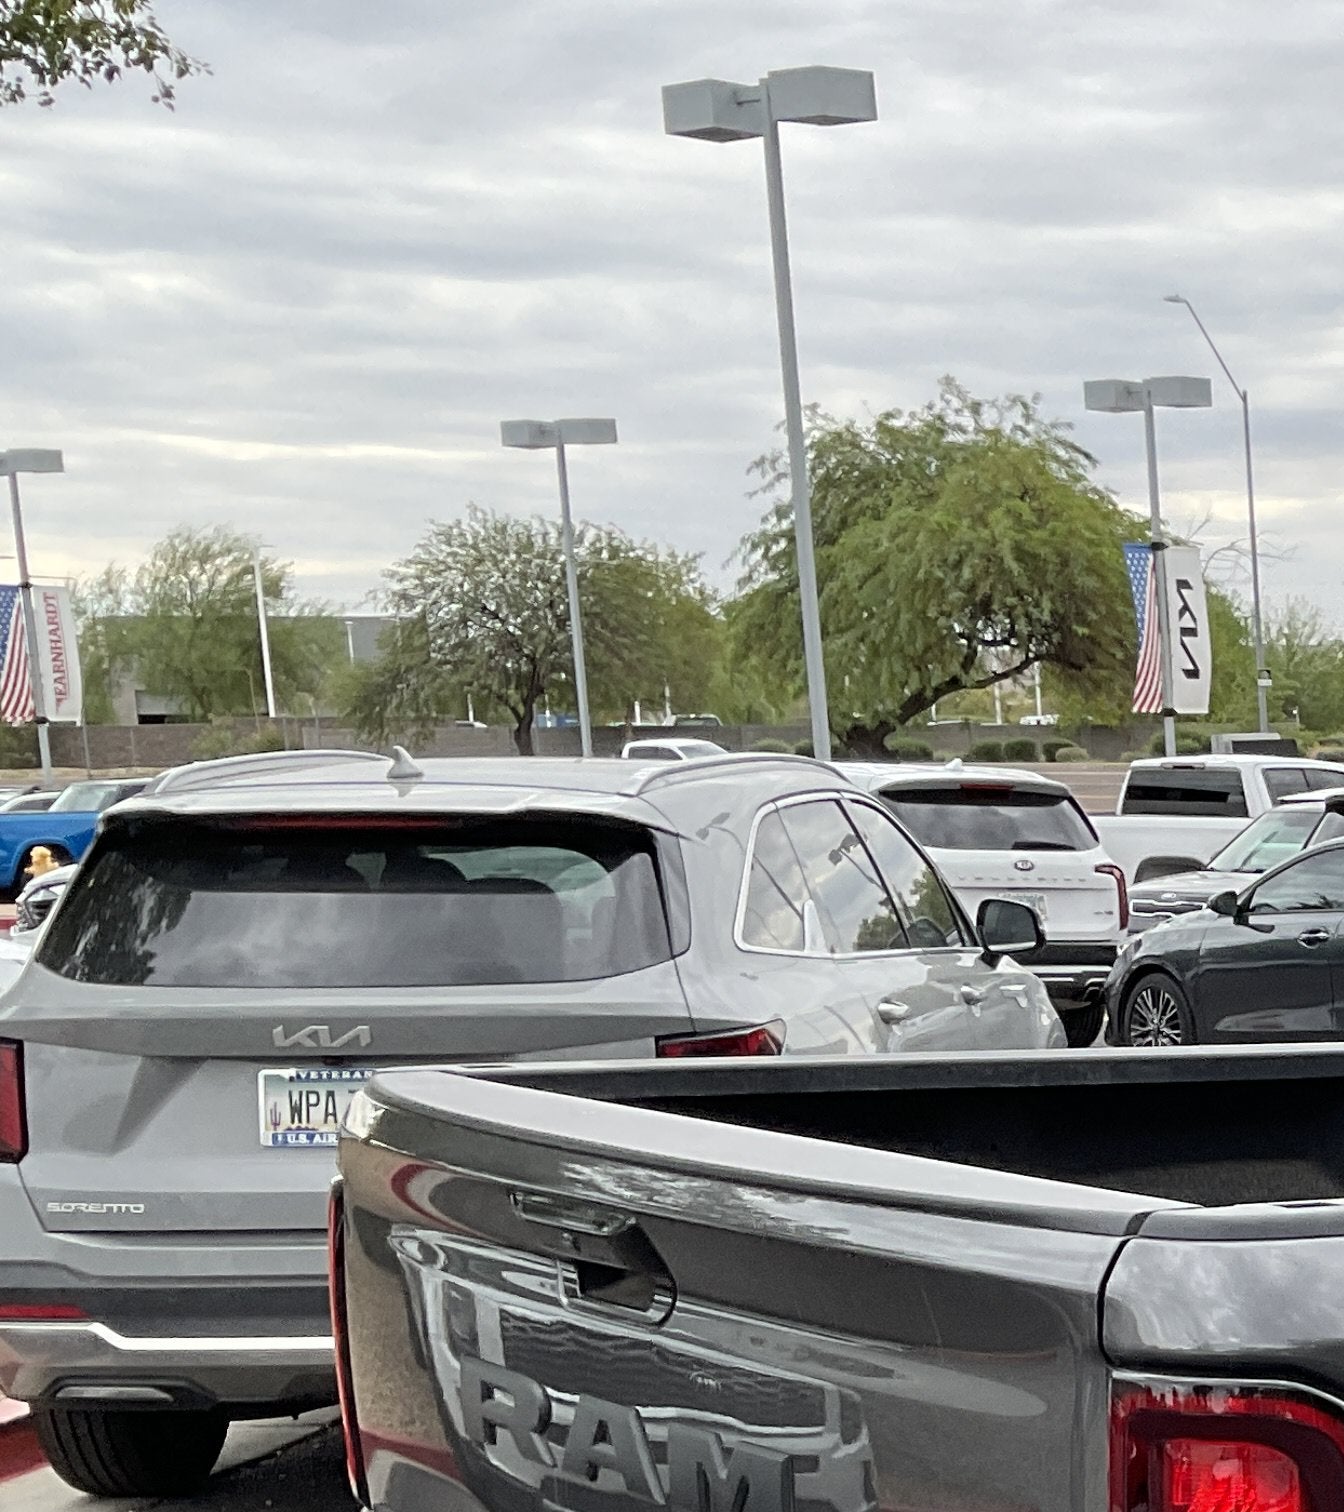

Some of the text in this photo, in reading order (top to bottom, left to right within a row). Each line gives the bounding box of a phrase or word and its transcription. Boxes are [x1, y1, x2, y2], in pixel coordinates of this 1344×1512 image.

[43, 591, 68, 711] EARNHARDT
[272, 1024, 372, 1048] KIA
[297, 1070, 373, 1080] VETERAN
[288, 1089, 338, 1125] WPA
[46, 1202, 145, 1214] SORENTO
